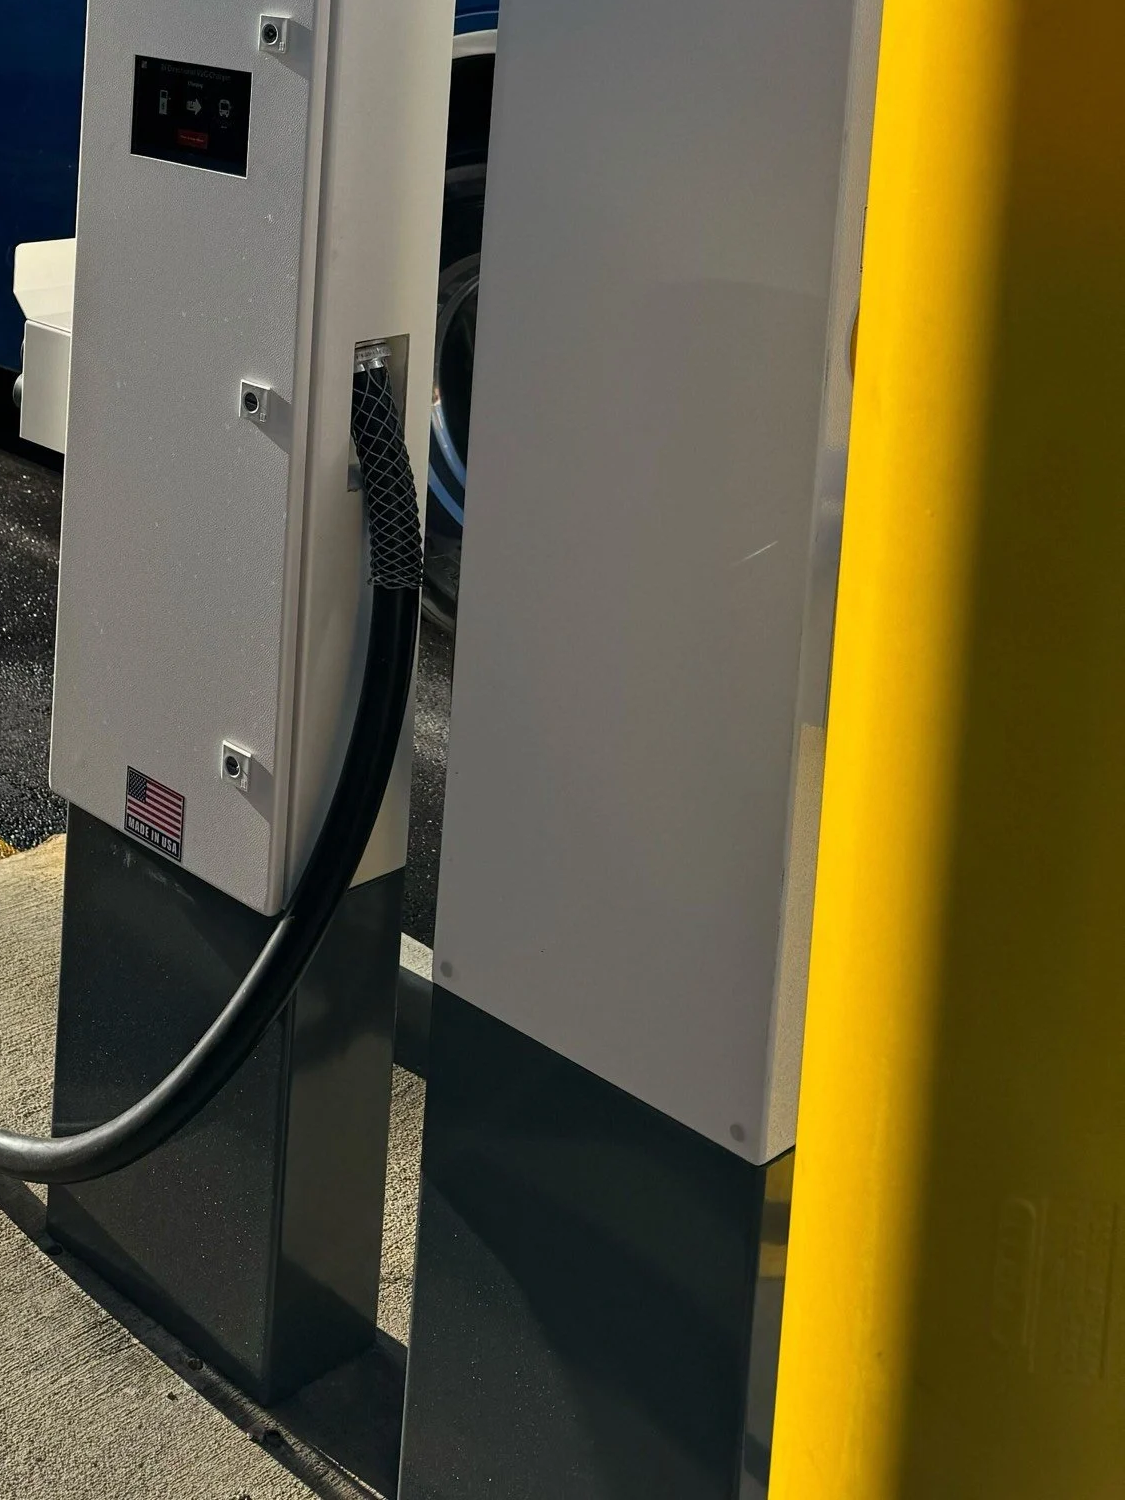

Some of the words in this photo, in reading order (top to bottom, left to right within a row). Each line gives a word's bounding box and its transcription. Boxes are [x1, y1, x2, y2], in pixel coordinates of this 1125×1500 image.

[128, 816, 150, 838] MADE
[151, 829, 160, 844] IN
[161, 834, 178, 855] USA
